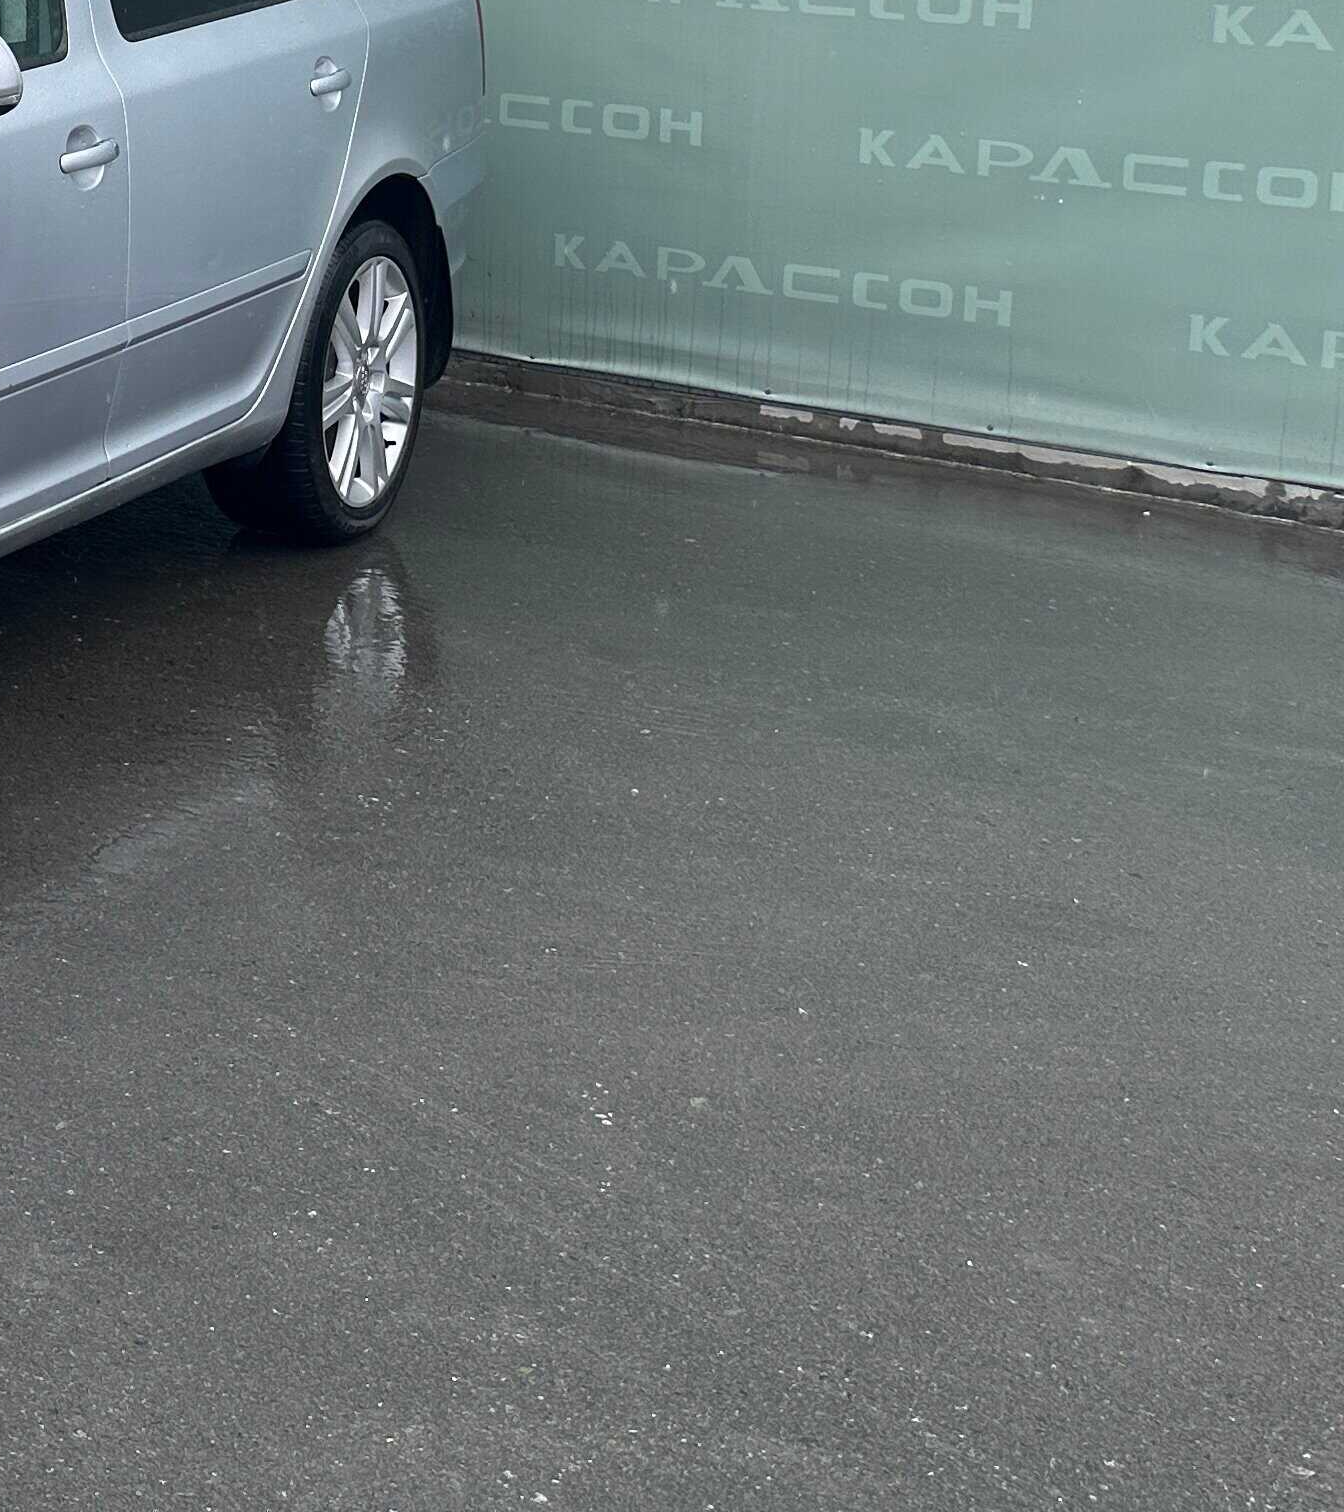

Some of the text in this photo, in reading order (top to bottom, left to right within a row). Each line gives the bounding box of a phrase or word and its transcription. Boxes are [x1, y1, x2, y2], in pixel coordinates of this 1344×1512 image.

[483, 92, 704, 147] ССОН
[859, 128, 1344, 212] КАРАССО
[554, 233, 1012, 327] КАРАССОН
